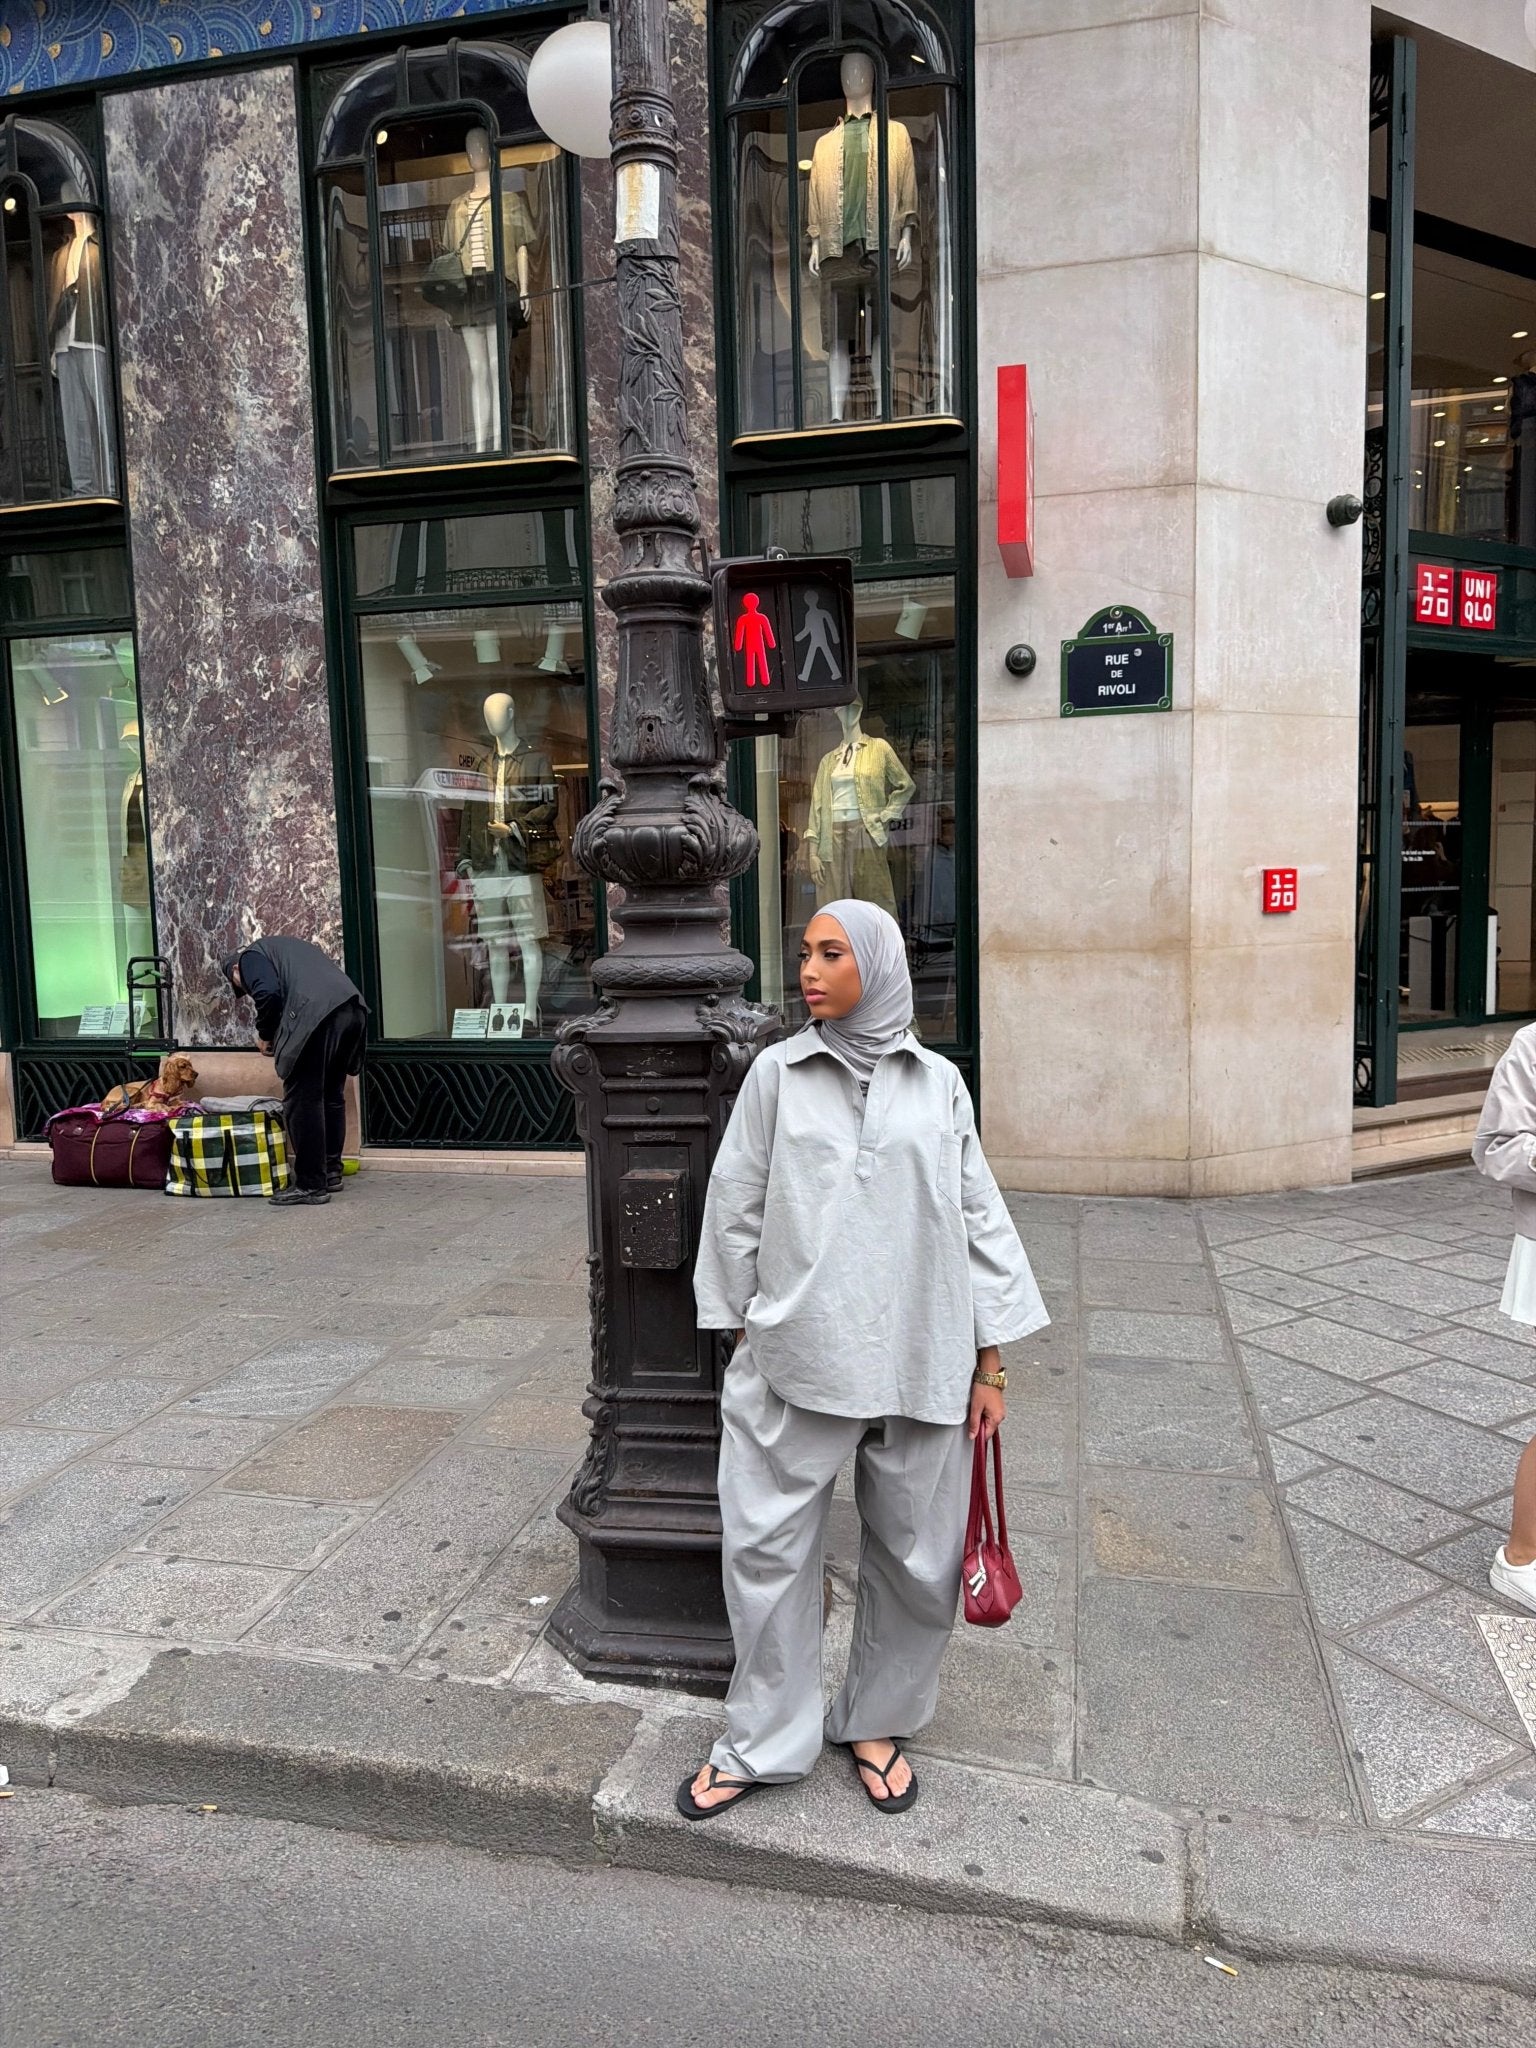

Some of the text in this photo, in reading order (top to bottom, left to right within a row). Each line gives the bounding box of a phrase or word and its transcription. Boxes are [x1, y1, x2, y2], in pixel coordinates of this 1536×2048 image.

[1465, 577, 1491, 600] UNI
[1464, 600, 1492, 624] QLO
[1104, 653, 1130, 666] RUE
[1110, 669, 1124, 679] DE
[1097, 683, 1137, 697] RIVOLI
